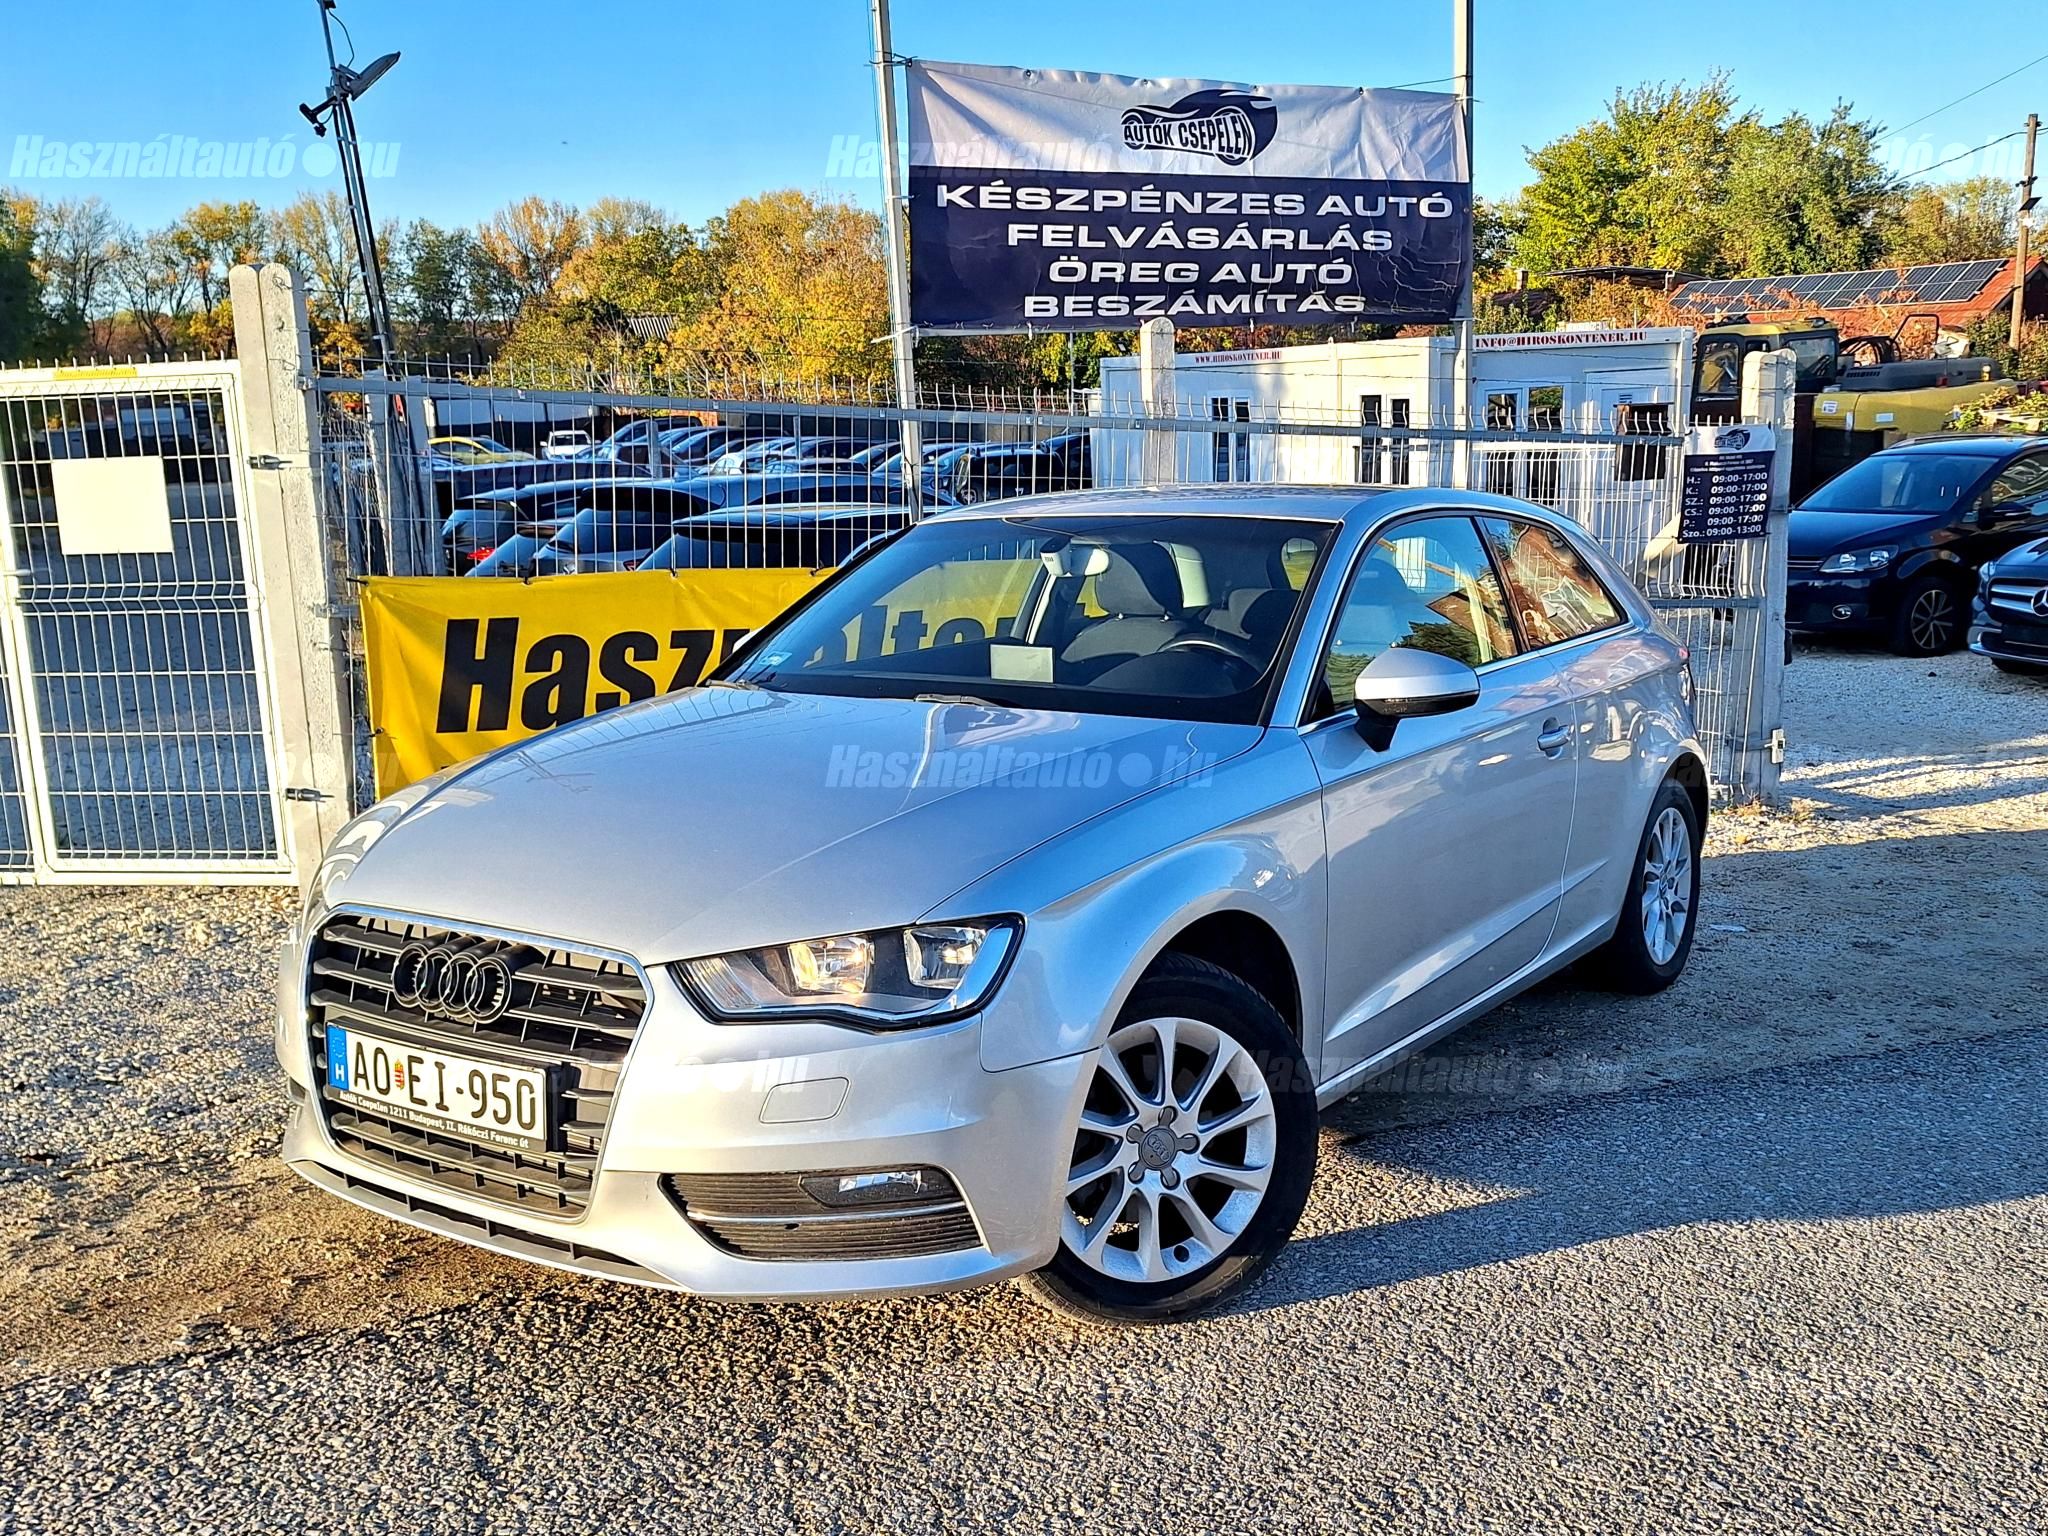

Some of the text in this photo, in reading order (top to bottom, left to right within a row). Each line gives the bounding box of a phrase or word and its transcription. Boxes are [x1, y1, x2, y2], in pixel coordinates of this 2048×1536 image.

[1124, 114, 1252, 156] AUTÓK CSEPELEN
[936, 179, 1454, 219] KÉSZPÉNZES AUTÓ
[1007, 220, 1393, 252] FELVÁSÁRLÁS
[1048, 253, 1353, 285] ÖREG AUTÓ
[1024, 288, 1367, 319] BESZÁMÍTÁS
[1474, 331, 1649, 349] INFO@HIROSKONTENER.HU
[1711, 472, 1768, 484] 09:00-17:00
[1710, 482, 1768, 494] 09:00-17:00
[1709, 493, 1767, 505] 09:00-17:00
[1708, 503, 1766, 516] 09:00-17:00
[1706, 514, 1764, 526] 09:00-17:00
[1706, 524, 1762, 537] 09:00-13:00
[334, 1062, 345, 1082] H
[358, 1096, 389, 1114] Csepelen
[389, 1105, 408, 1119] 1211
[408, 1110, 445, 1130] Budapest,
[490, 1130, 519, 1146] Ferenc
